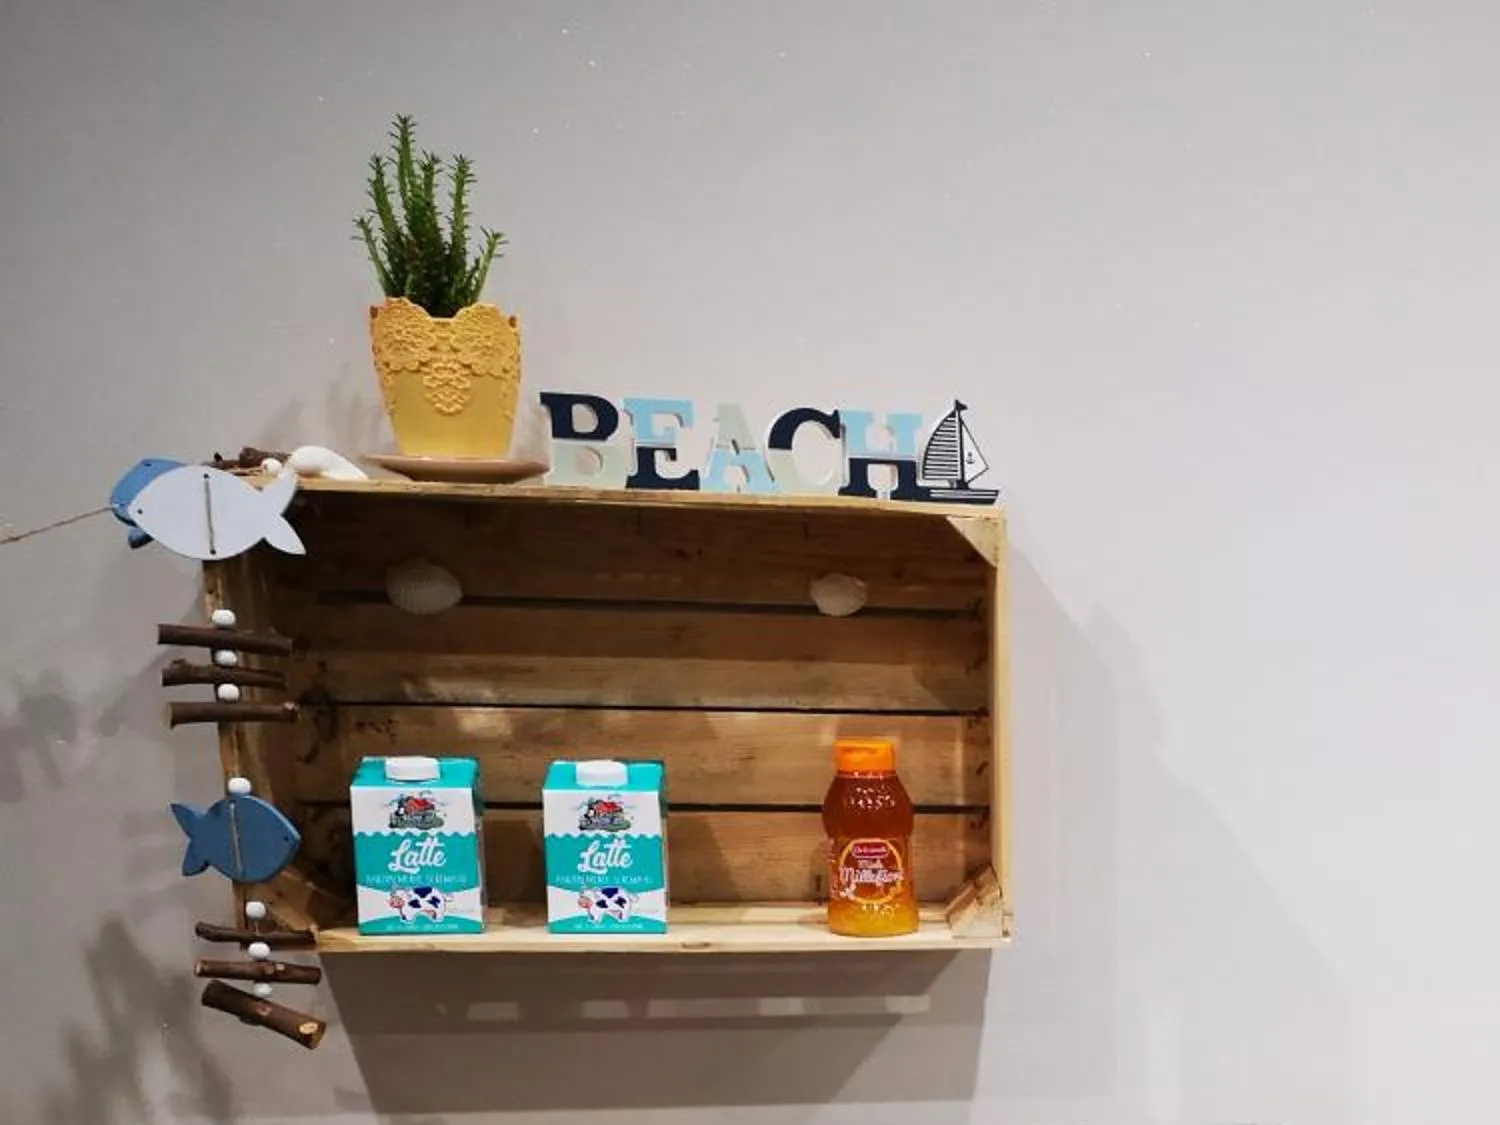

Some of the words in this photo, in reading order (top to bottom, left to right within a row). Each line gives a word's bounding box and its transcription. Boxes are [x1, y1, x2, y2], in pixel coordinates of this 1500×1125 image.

[540, 391, 930, 500] BEACH
[388, 837, 446, 874] Latte
[577, 838, 633, 874] Latte
